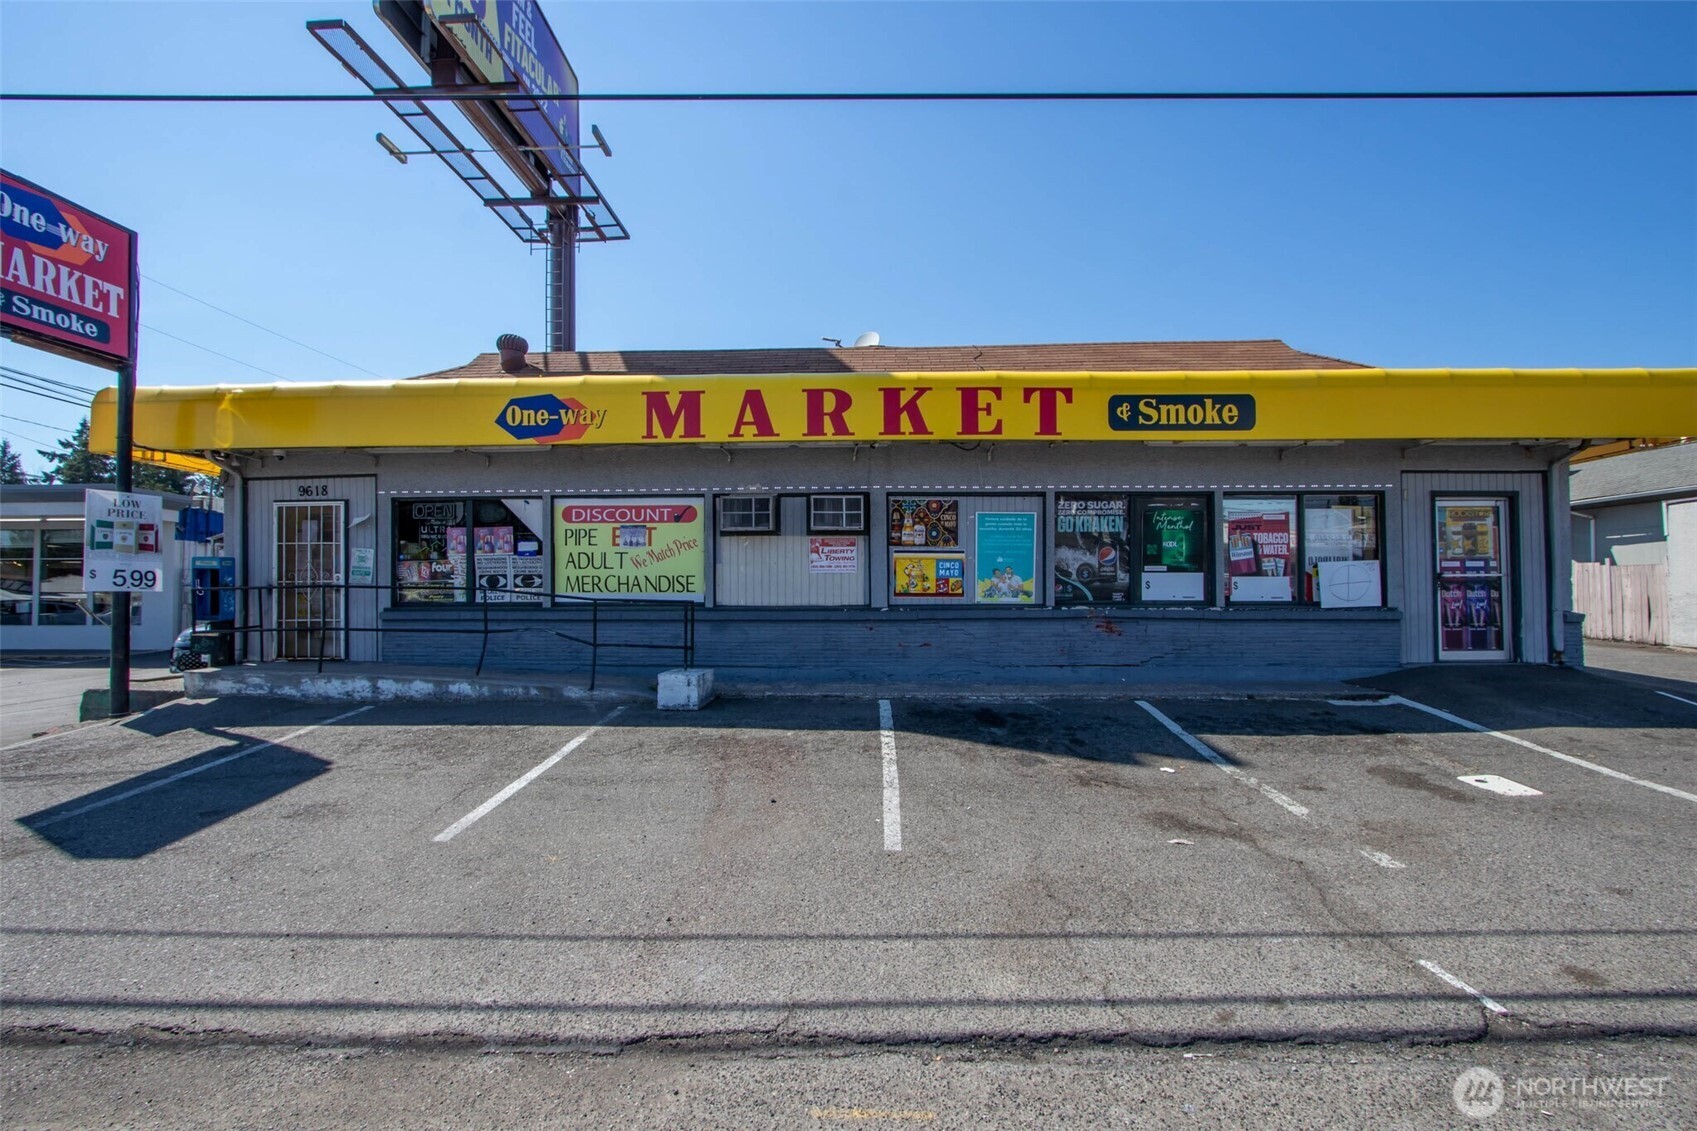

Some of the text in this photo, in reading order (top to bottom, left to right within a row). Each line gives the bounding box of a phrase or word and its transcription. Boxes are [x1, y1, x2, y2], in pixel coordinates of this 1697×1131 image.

[512, 2, 537, 56] FEEL
[504, 22, 560, 108] FITACULAR
[12, 295, 98, 337] Smoke
[506, 387, 1239, 439] One-way MARKET & Smoke
[298, 484, 328, 497] 9618
[113, 498, 141, 509] LOW
[1057, 501, 1126, 509] ZERO SUGAR.
[107, 508, 147, 520] PRICE
[415, 503, 452, 518] OPEN
[571, 508, 672, 522] DISCOUNT
[1057, 515, 1124, 532] GO KRAKEN
[1152, 511, 1185, 524] Intense
[420, 525, 452, 534] ULTR
[1156, 520, 1194, 532] Menthol
[564, 528, 598, 546] PIPE
[1253, 532, 1289, 544] TOBACCO
[630, 536, 699, 570] We Match Price
[1263, 544, 1289, 555] WATER.
[565, 551, 629, 570] ADULT
[939, 561, 960, 569] CINCO
[112, 569, 157, 589] 5.99
[939, 569, 960, 577] MAYO
[565, 574, 696, 593] MERCHANDISE
[1145, 580, 1151, 590] $
[1233, 581, 1239, 590] $
[1441, 590, 1462, 598] Dutch
[1466, 590, 1486, 598] Dutch
